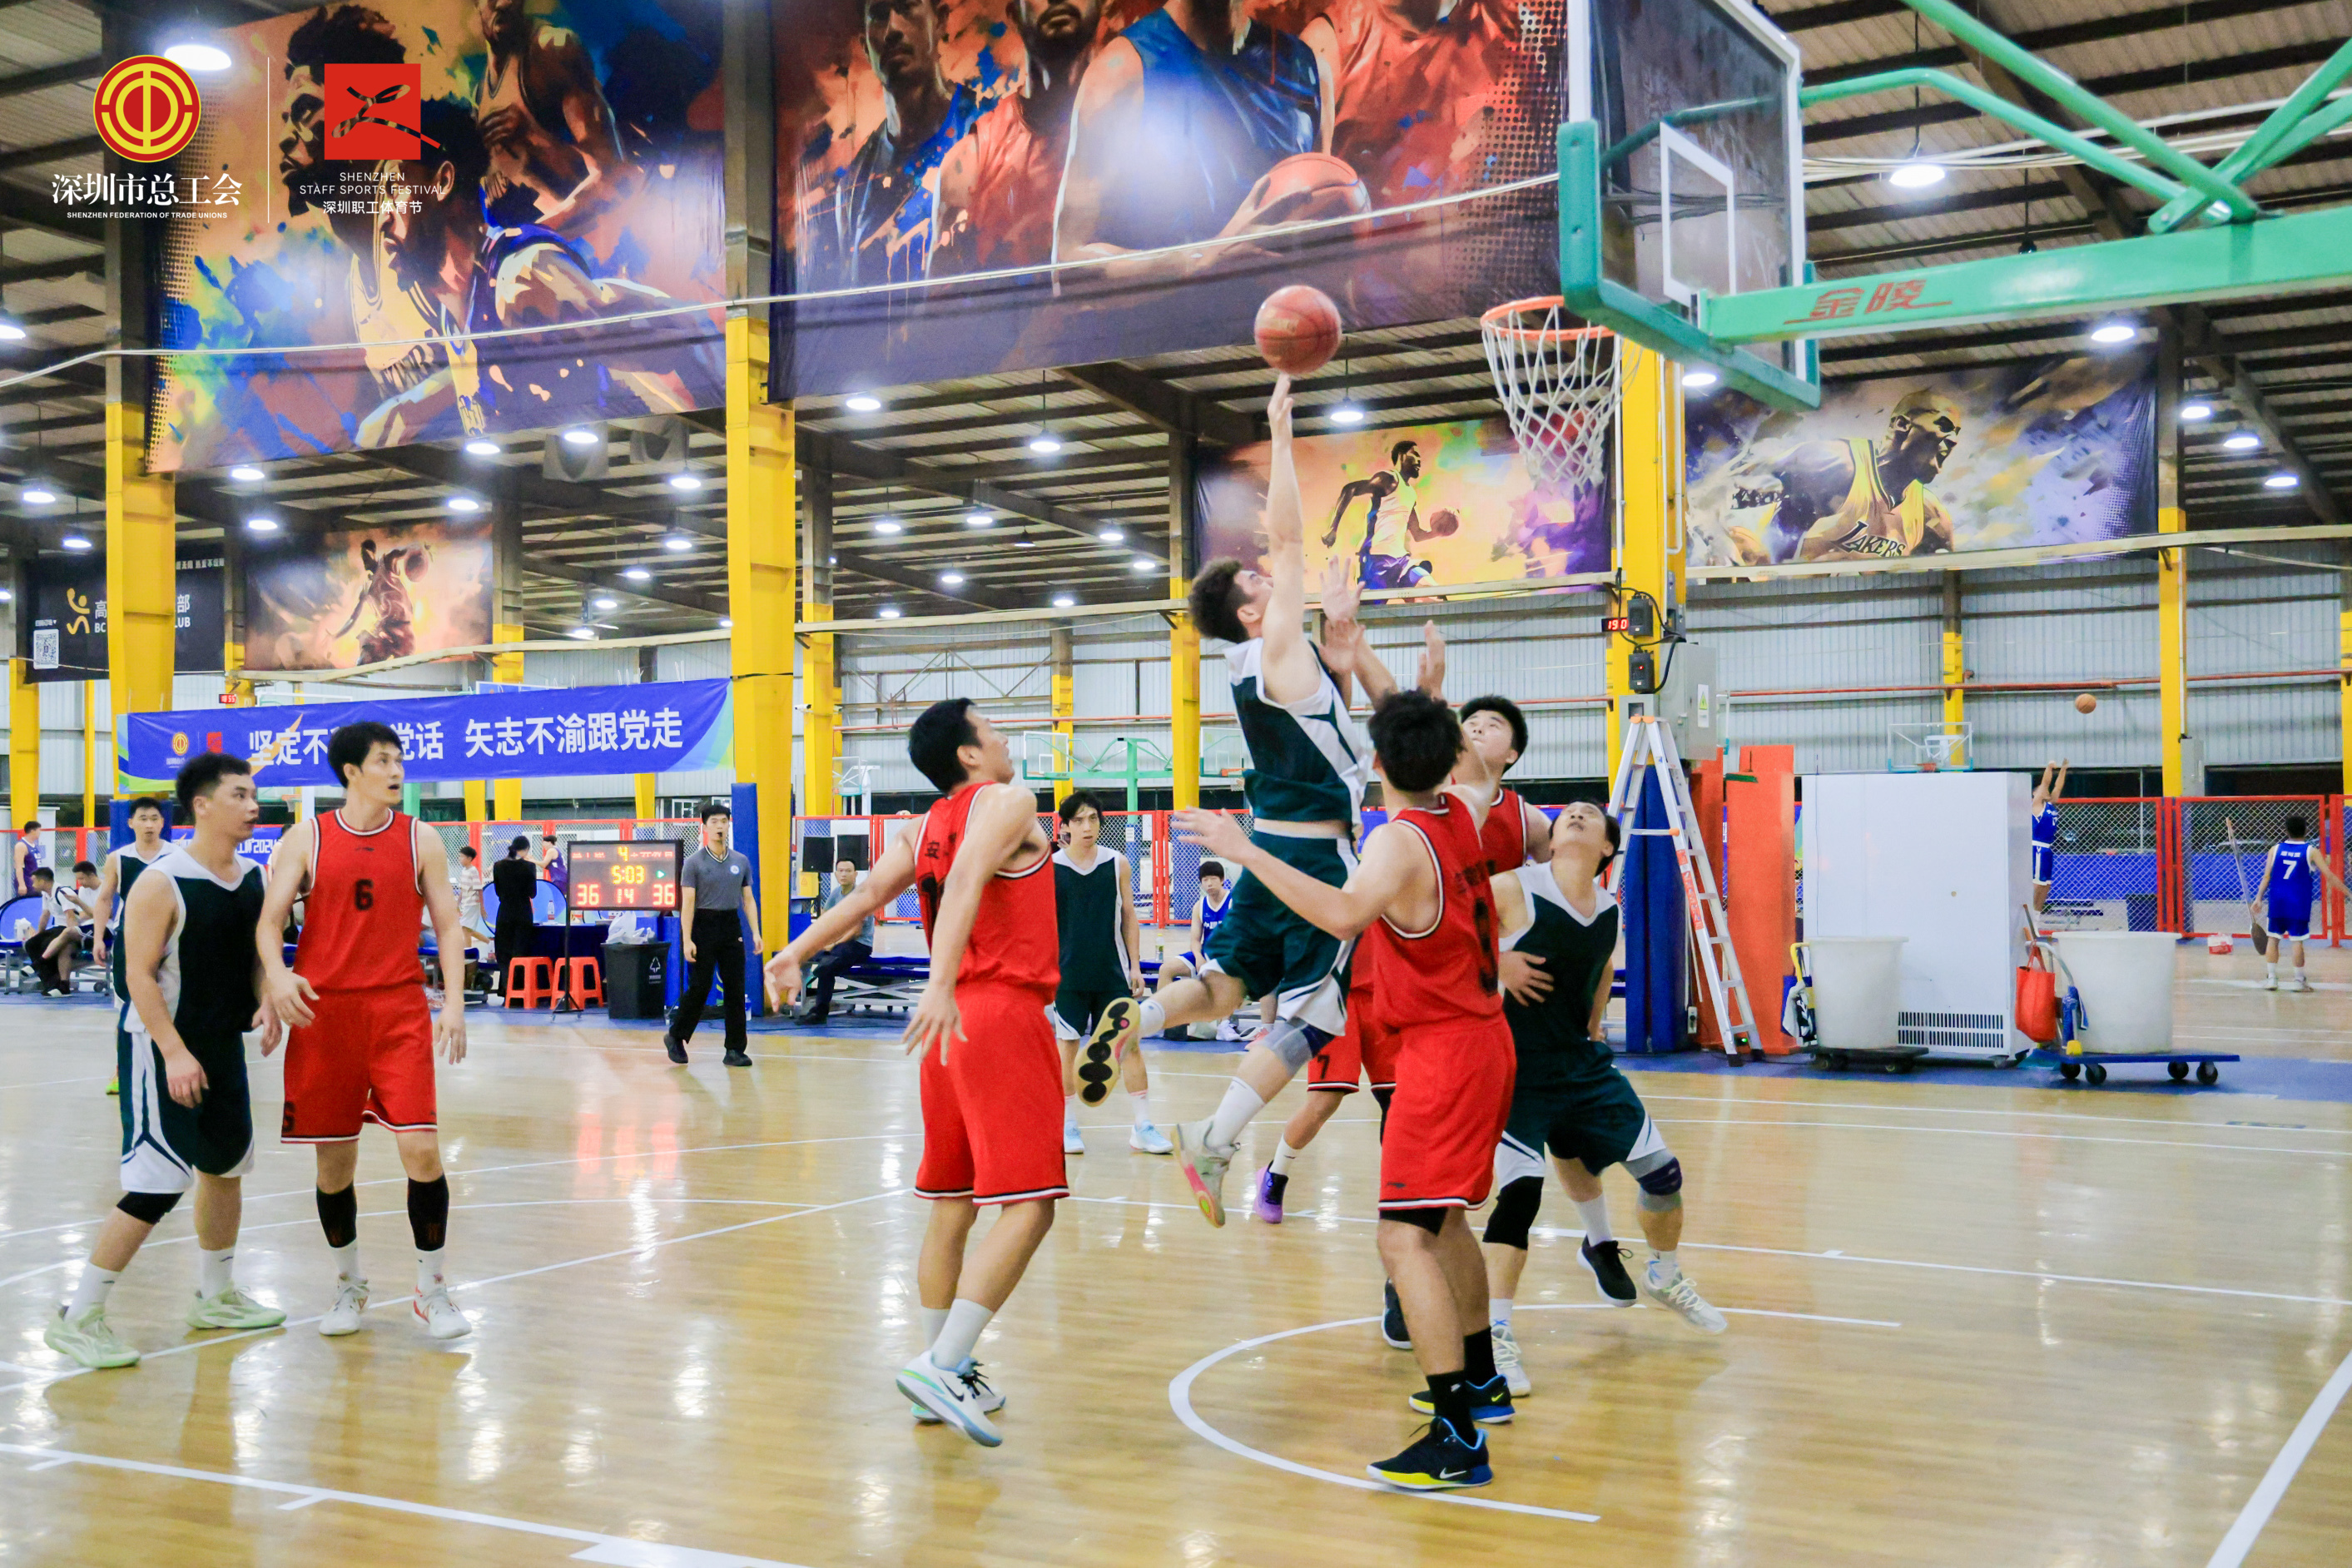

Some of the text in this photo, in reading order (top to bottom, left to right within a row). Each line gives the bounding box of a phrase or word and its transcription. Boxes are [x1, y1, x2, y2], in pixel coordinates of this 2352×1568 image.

[1832, 520, 1907, 557] LAKERS
[465, 707, 683, 759] 矢志不渝跟党走
[618, 846, 628, 862] 4
[611, 865, 645, 884] 5:03
[2283, 859, 2297, 880] 7
[355, 879, 374, 911] 6
[577, 883, 675, 906] 36 14 36
[1317, 1054, 1330, 1080] 7
